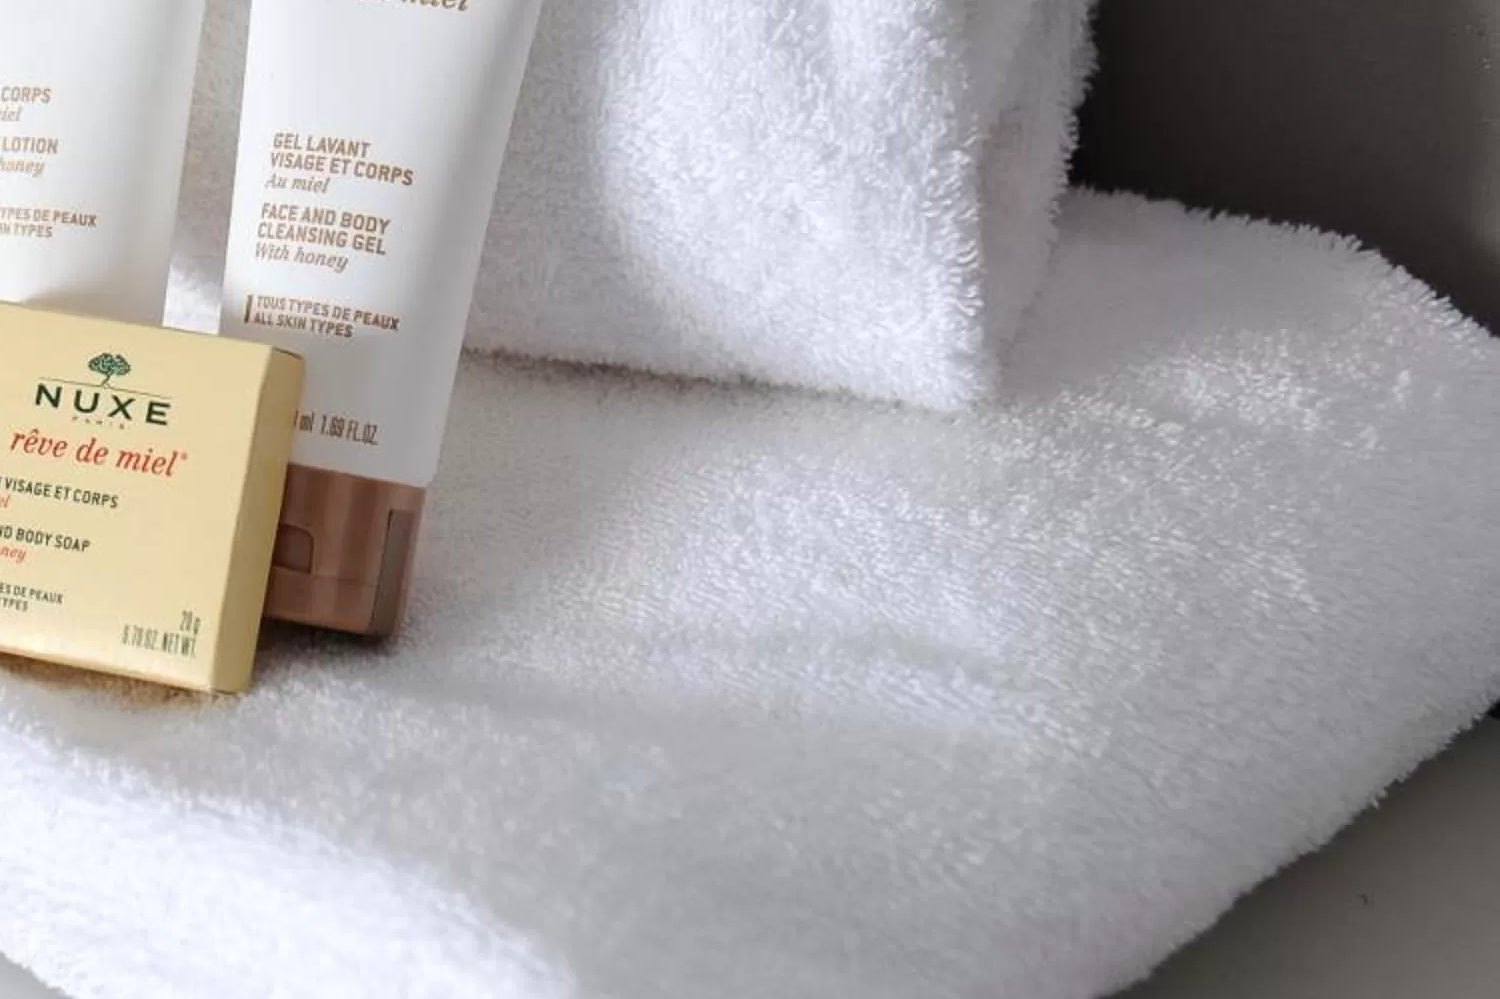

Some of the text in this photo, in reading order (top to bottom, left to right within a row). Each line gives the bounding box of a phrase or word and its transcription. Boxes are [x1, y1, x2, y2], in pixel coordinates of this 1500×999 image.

[1, 87, 52, 104] CORPS
[3, 137, 58, 154] LOTION
[273, 132, 371, 159] GEL LAVANT
[265, 173, 331, 194] Au miel
[270, 152, 414, 186] VISAGE ET CORPS
[32, 209, 50, 223] DE
[51, 210, 98, 227] PEAUX
[261, 203, 392, 236] FACE AND BODY
[257, 223, 387, 256] CLEANSING GEL
[255, 242, 349, 274] With honey
[253, 313, 353, 338] ALL SKIN TYPES
[256, 296, 400, 332] TOUS TYPES DE PEAUX
[35, 383, 171, 426] NUXE
[9, 428, 68, 458] rêve
[75, 437, 109, 465] de
[5, 476, 52, 498] VISAGE
[54, 486, 72, 500] ET
[73, 488, 119, 509] CORPS
[16, 527, 52, 546] BODY
[54, 534, 91, 552] SOAP
